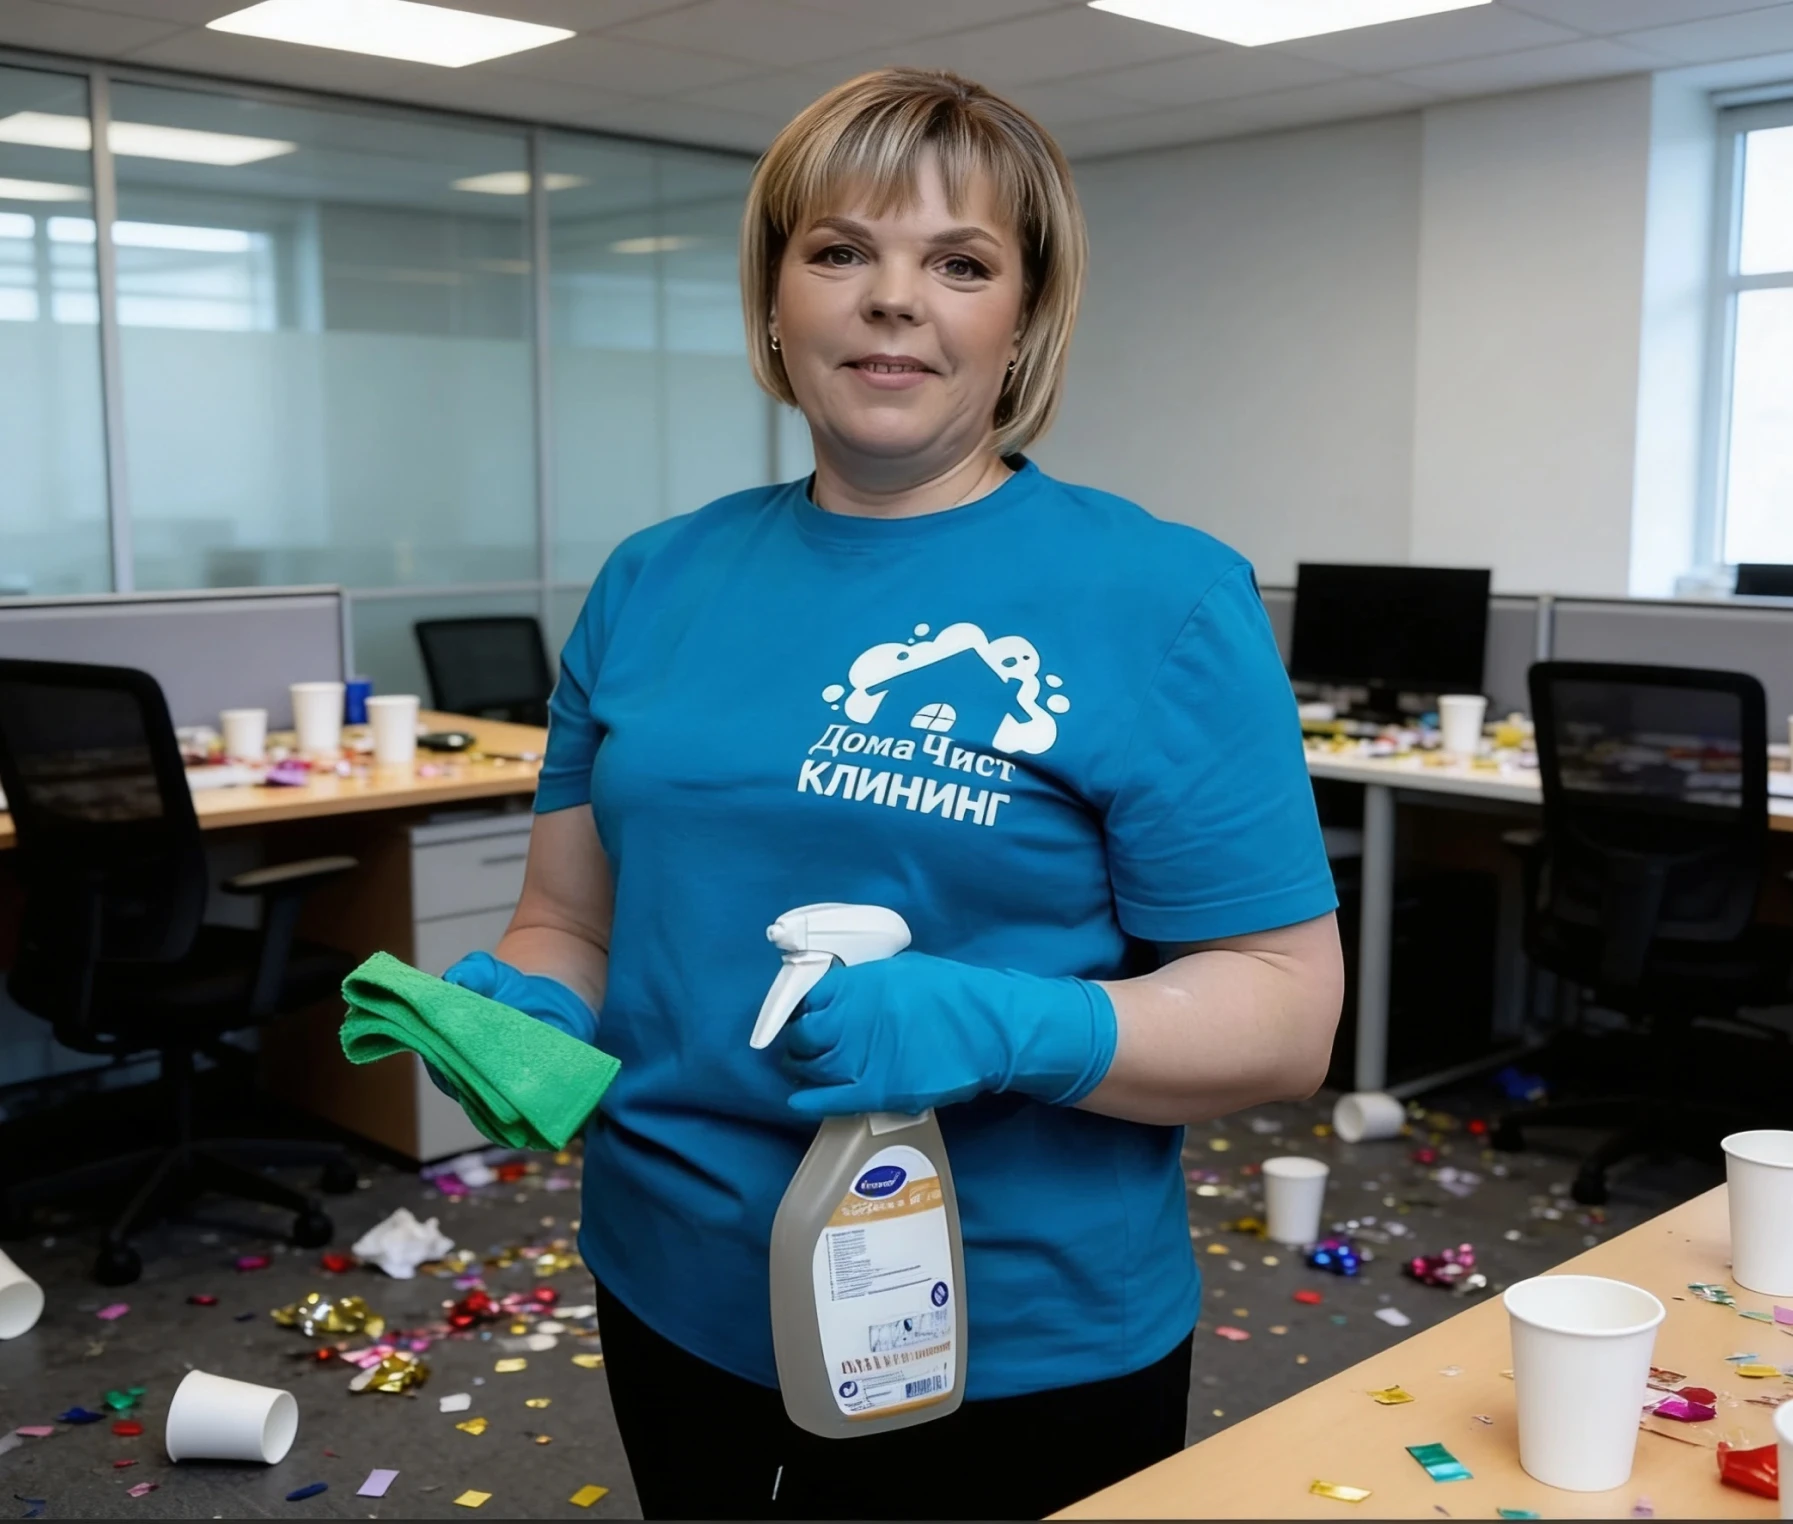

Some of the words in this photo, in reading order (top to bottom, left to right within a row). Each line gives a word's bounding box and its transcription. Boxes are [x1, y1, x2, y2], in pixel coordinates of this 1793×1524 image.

[808, 724, 915, 760] Дома
[922, 734, 1016, 782] Чист
[797, 759, 1011, 827] КЛИНИНГ
